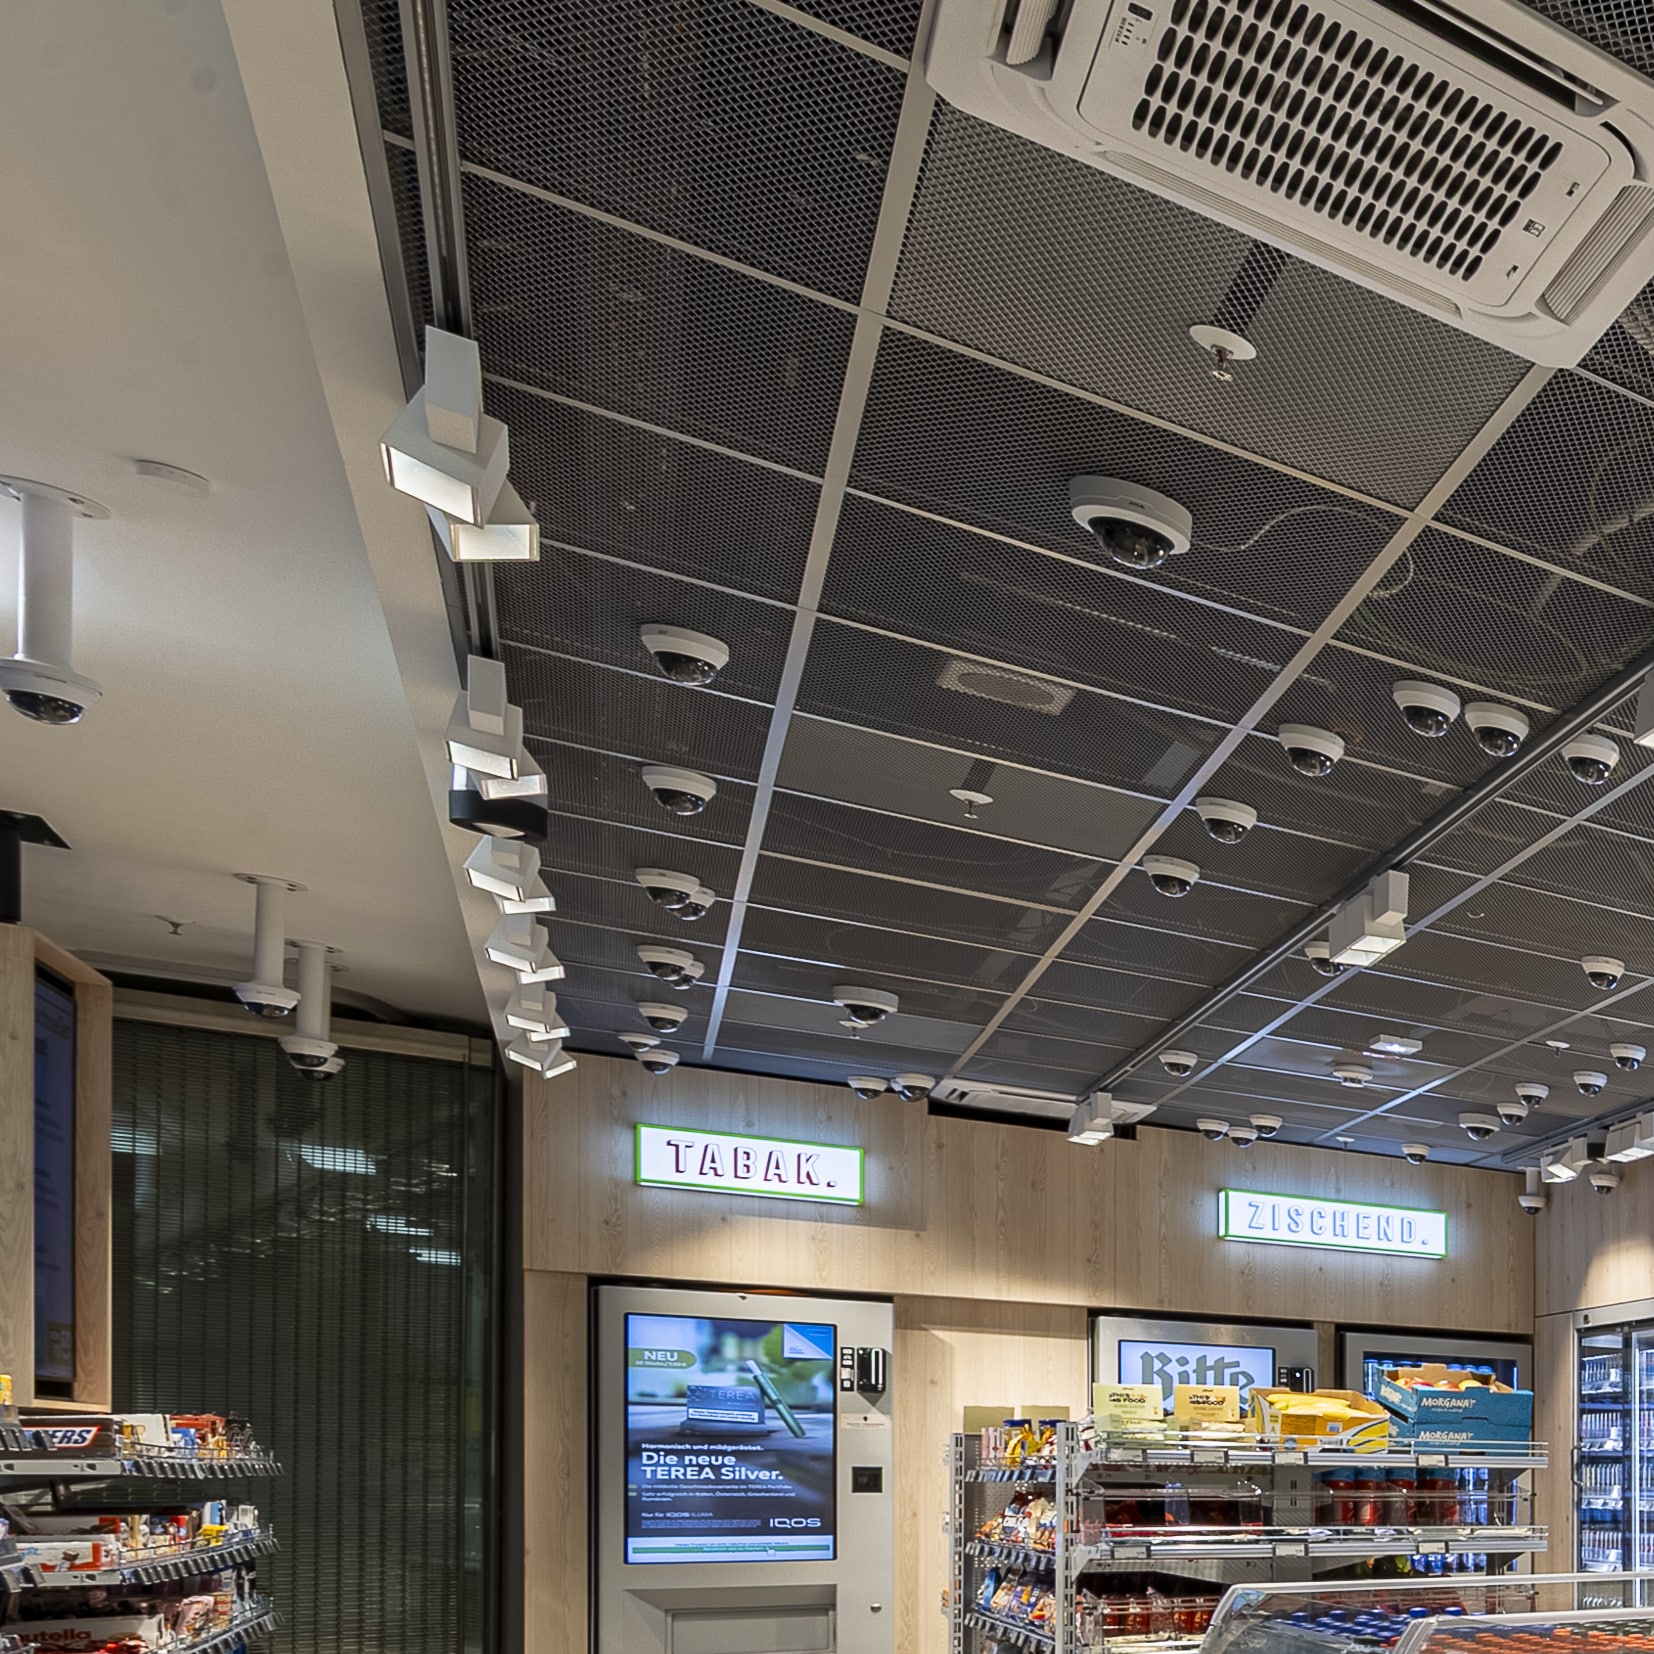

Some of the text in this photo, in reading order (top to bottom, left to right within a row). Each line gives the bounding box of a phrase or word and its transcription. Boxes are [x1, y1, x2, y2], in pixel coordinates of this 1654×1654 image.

[666, 1138, 838, 1188] TABAK.
[1248, 1199, 1430, 1246] ZISCHEND.
[643, 1350, 679, 1362] NEU
[710, 1389, 756, 1401] TEREA
[641, 1451, 737, 1466] Die neue
[641, 1466, 785, 1481] TEREA Silver.
[769, 1517, 822, 1529] IQOS
